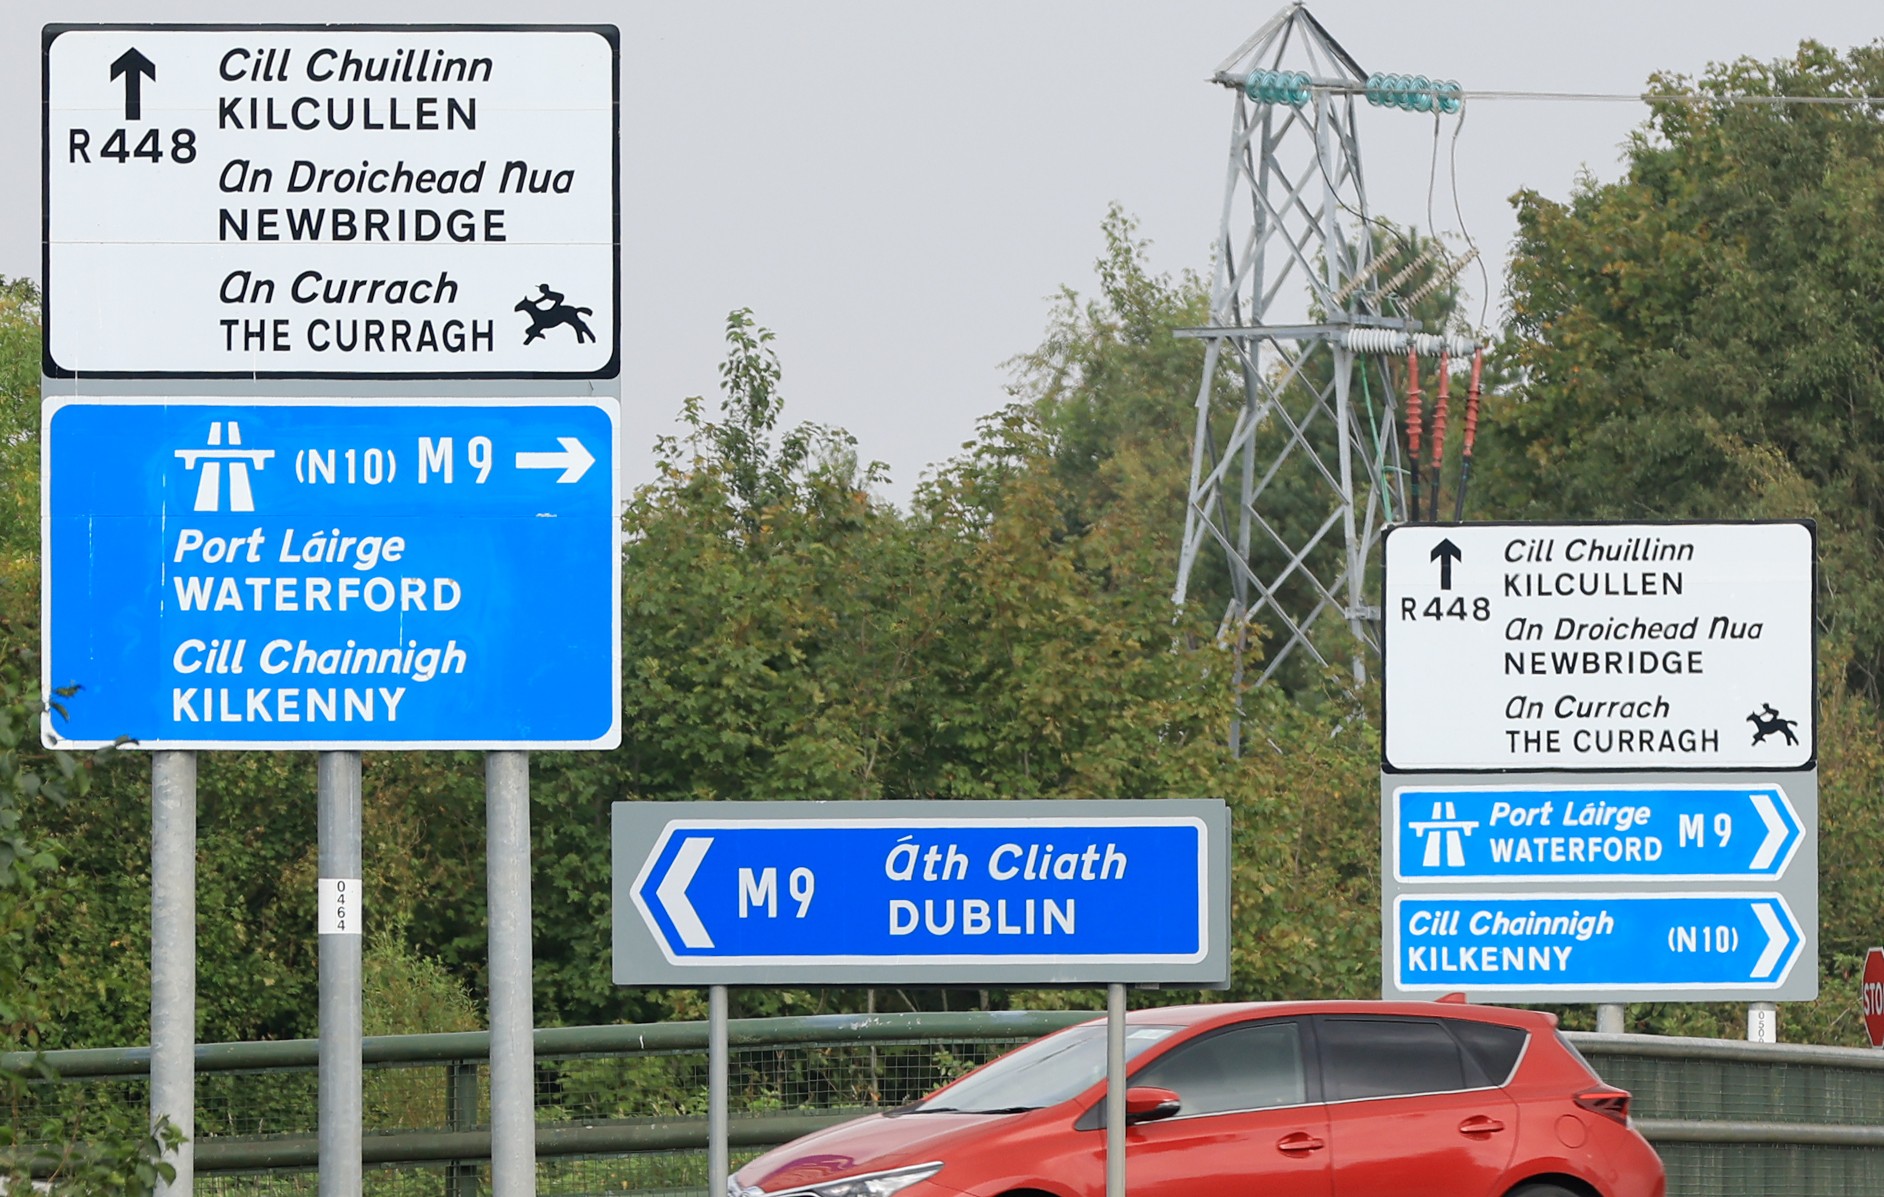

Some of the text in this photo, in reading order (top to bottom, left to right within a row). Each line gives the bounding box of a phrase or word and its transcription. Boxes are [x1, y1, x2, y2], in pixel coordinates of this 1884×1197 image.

[220, 48, 492, 82] Cill Chuillinn
[220, 97, 475, 130] KILCULLEN
[287, 160, 486, 193] Droichead
[220, 209, 506, 242] NEWBRIDGE
[292, 271, 457, 304] Currach
[220, 319, 493, 352] THE CURRAGH
[174, 528, 405, 570] Port Láirge
[1505, 538, 1693, 562] Cill Chuillinn
[174, 577, 461, 612] WATERFORD
[1505, 573, 1682, 596] KILCULLEN
[1555, 617, 1698, 640] Droichead
[174, 637, 466, 682] Cill Chainnigh
[1505, 651, 1702, 674] NEWBRIDGE
[173, 688, 405, 722] KILKENNY
[1555, 695, 1669, 718] Currach
[1506, 730, 1718, 753] THE CURRAGH
[1490, 801, 1650, 831] Port Láirge
[989, 844, 1126, 880] Cliath
[1490, 837, 1662, 862] WATERFORD
[890, 899, 1074, 935] DUBLIN
[1409, 911, 1614, 940] Cill Chainnigh
[1409, 946, 1572, 971] KILKENNY
[1864, 982, 1884, 1016] STO
